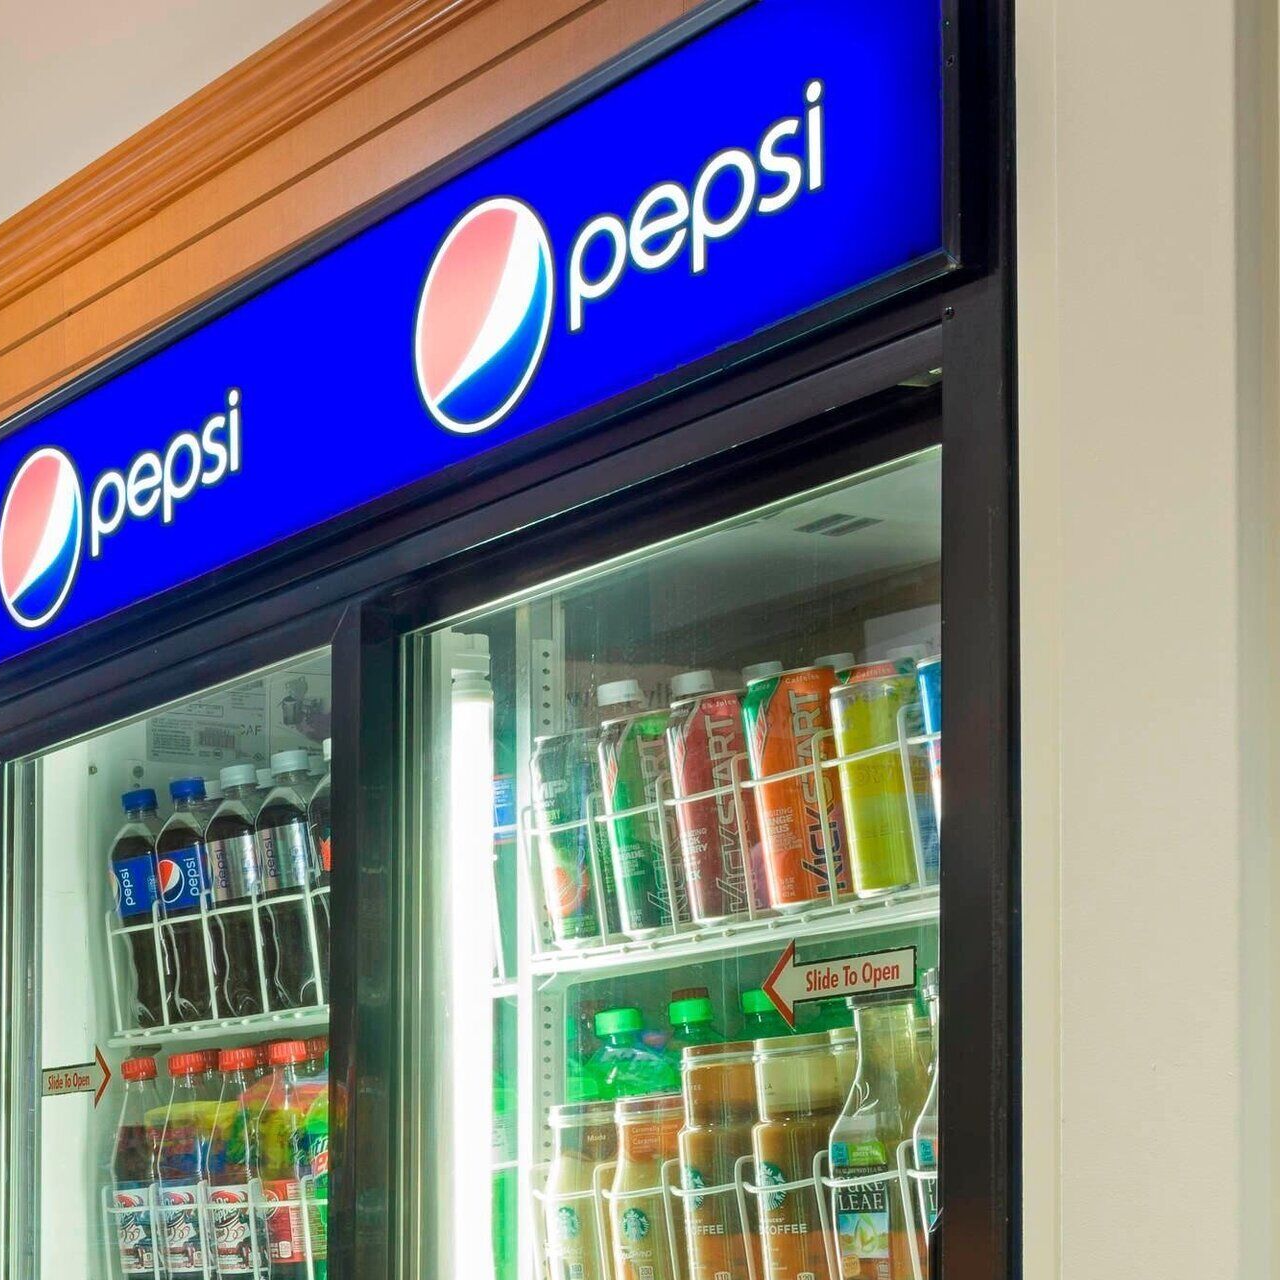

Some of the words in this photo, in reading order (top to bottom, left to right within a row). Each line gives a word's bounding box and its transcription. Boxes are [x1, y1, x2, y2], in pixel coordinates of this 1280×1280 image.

[567, 78, 826, 332] pepsi
[89, 388, 242, 559] pepsi
[120, 868, 136, 906] pepsi
[188, 858, 203, 897] pepsi
[805, 969, 841, 993] Slide
[844, 967, 859, 987] To
[861, 961, 900, 984] Open
[48, 1076, 63, 1090] Slide
[64, 1074, 72, 1087] To
[72, 1070, 91, 1087] Open
[840, 1193, 882, 1211] LEAF
